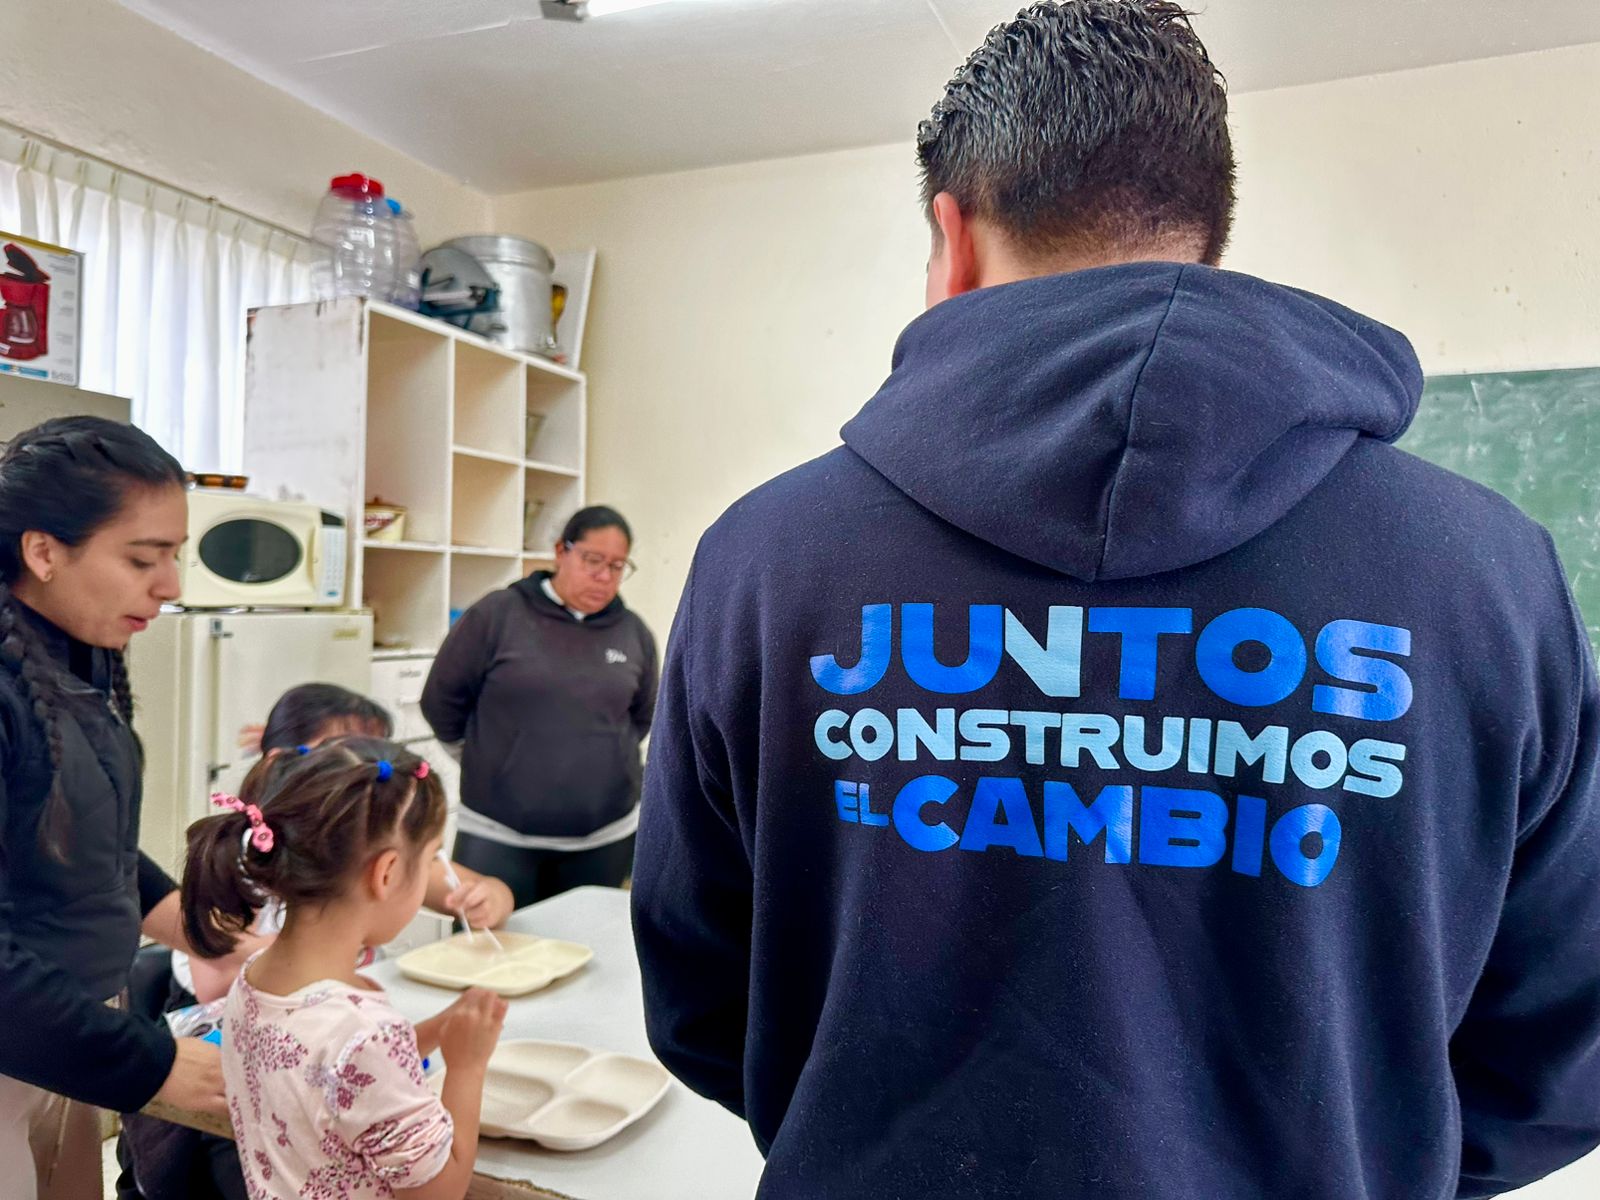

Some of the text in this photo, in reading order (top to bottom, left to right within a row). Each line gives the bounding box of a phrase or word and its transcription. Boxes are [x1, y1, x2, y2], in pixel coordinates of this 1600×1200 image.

[809, 603, 1413, 721] JUNTOS
[814, 708, 1406, 798] CONSTRUIMOS
[834, 775, 1342, 887] EL CAMBIO
